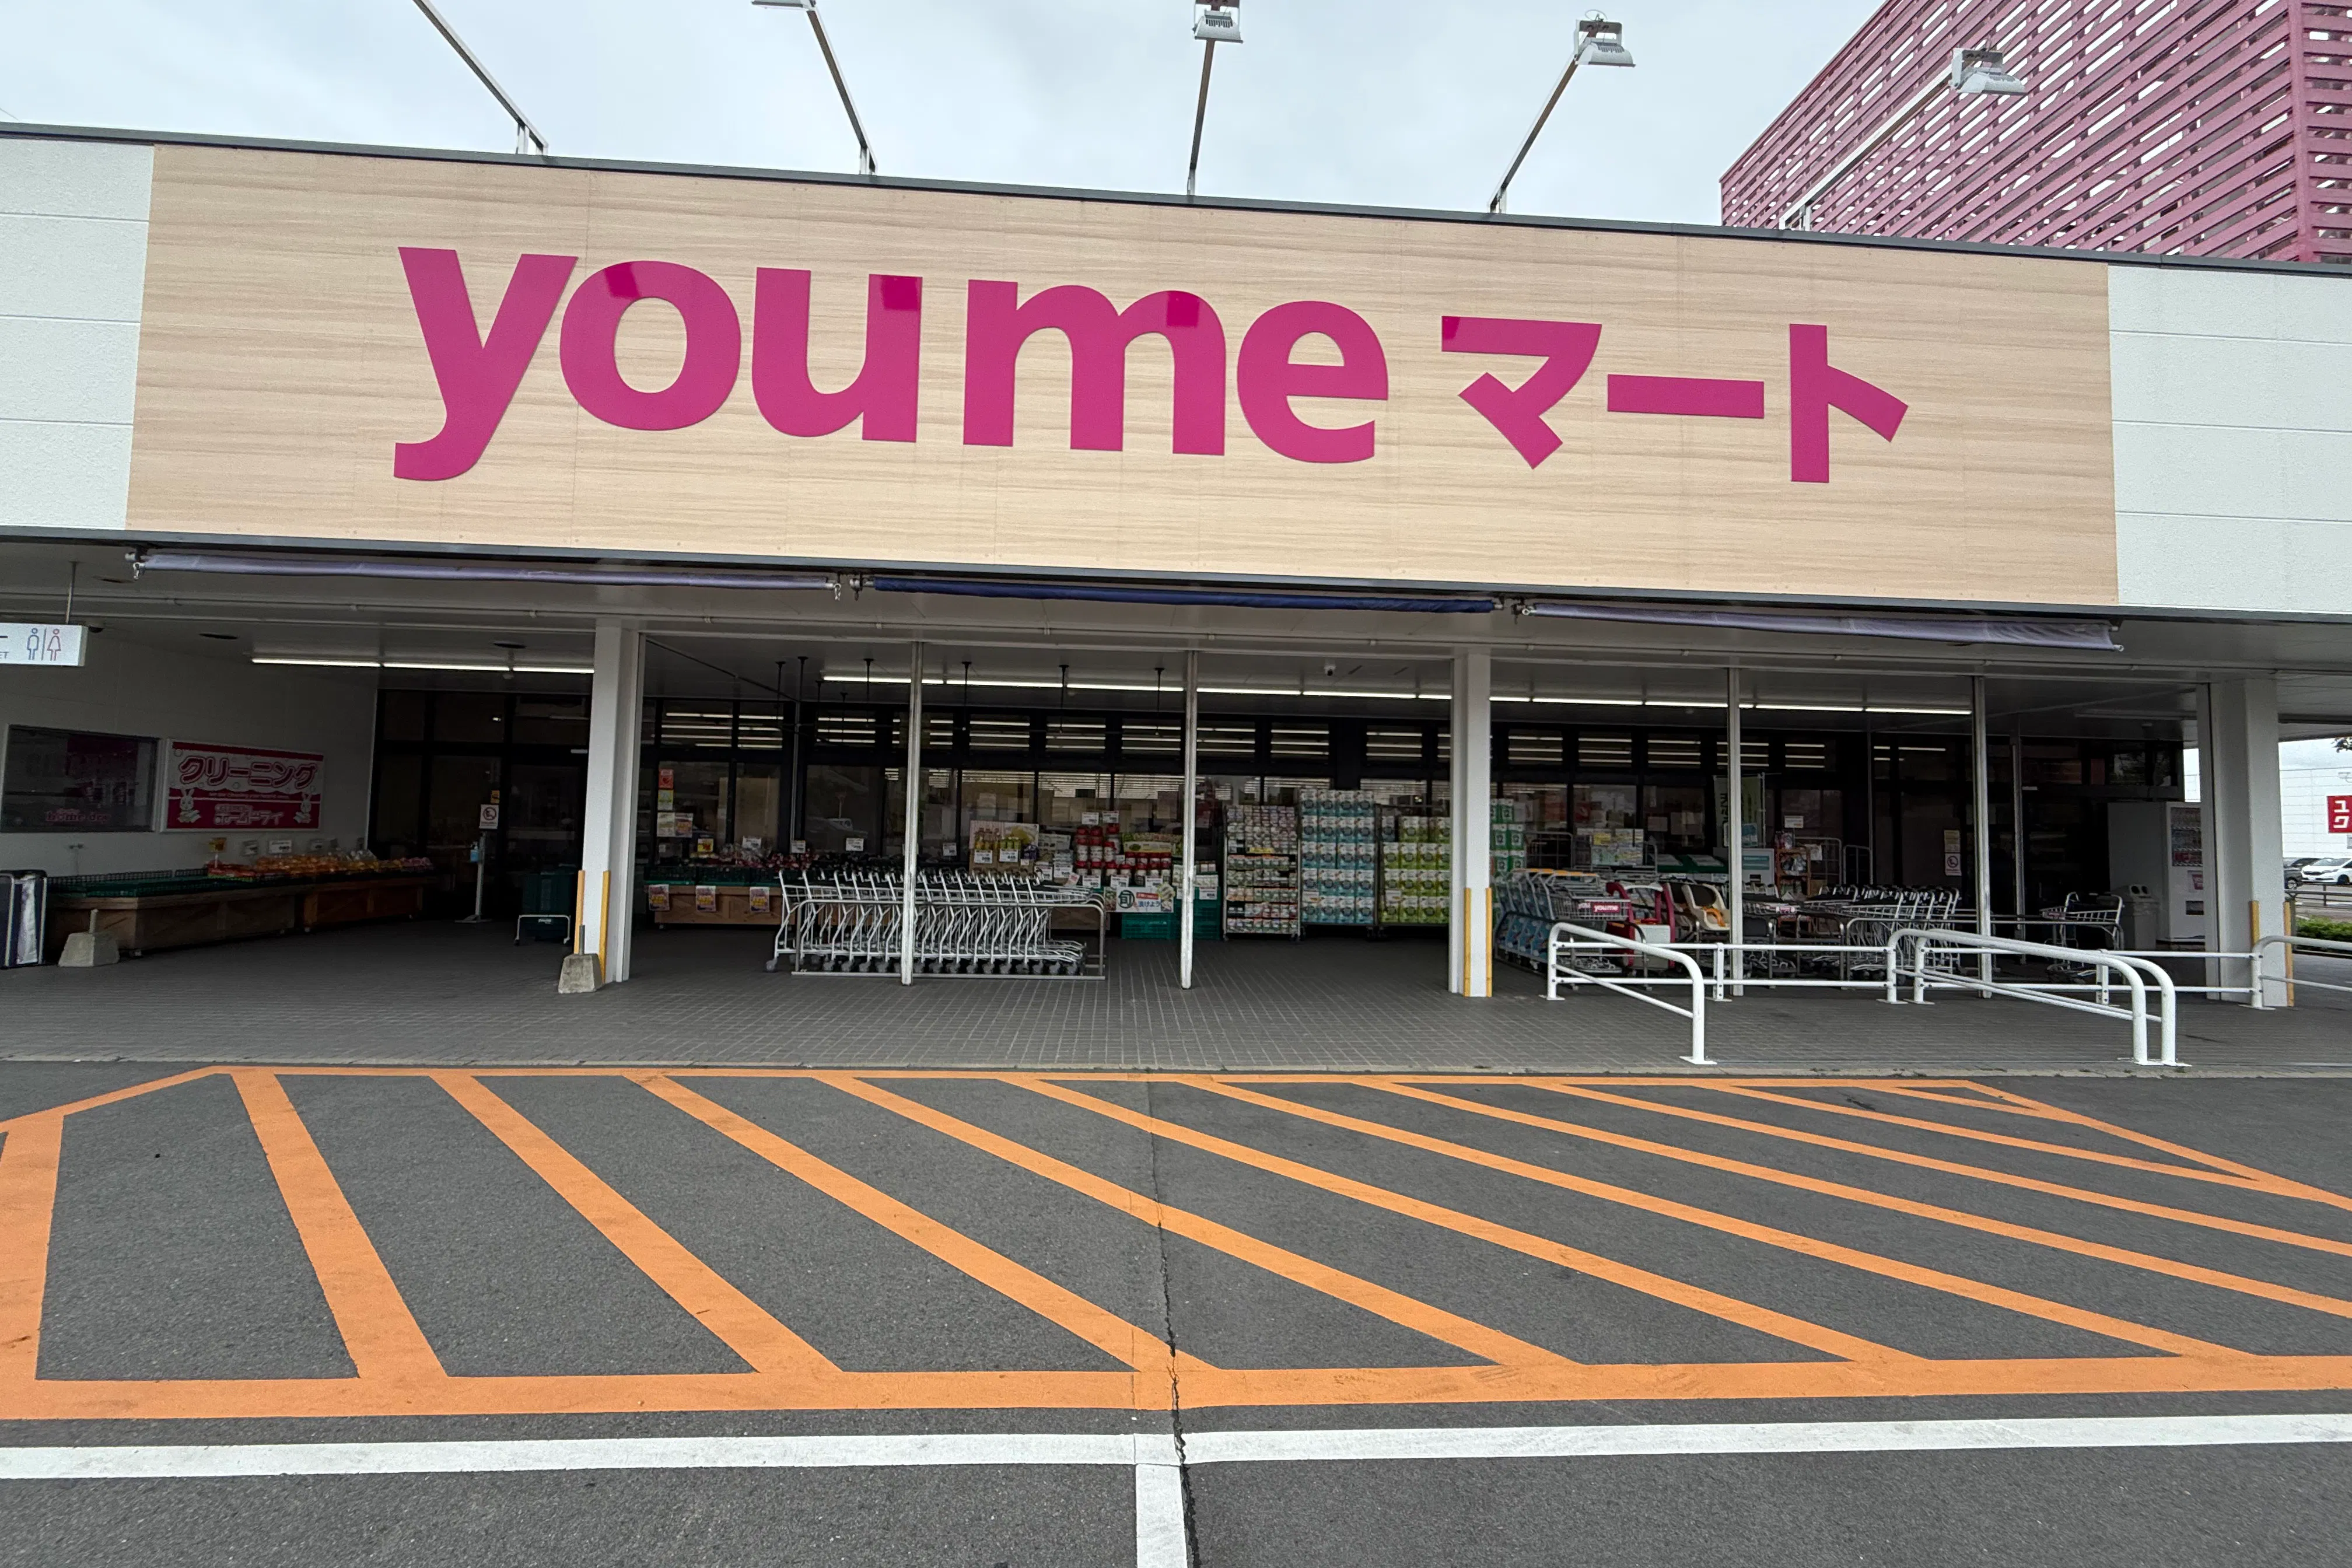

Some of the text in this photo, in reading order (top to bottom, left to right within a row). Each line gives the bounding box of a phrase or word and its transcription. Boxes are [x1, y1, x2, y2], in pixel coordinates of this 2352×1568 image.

[178, 755, 318, 789] クリーニング
[214, 810, 285, 826] ホームドライ
[1118, 891, 1134, 908] 旬
[1594, 904, 1619, 912] youme
